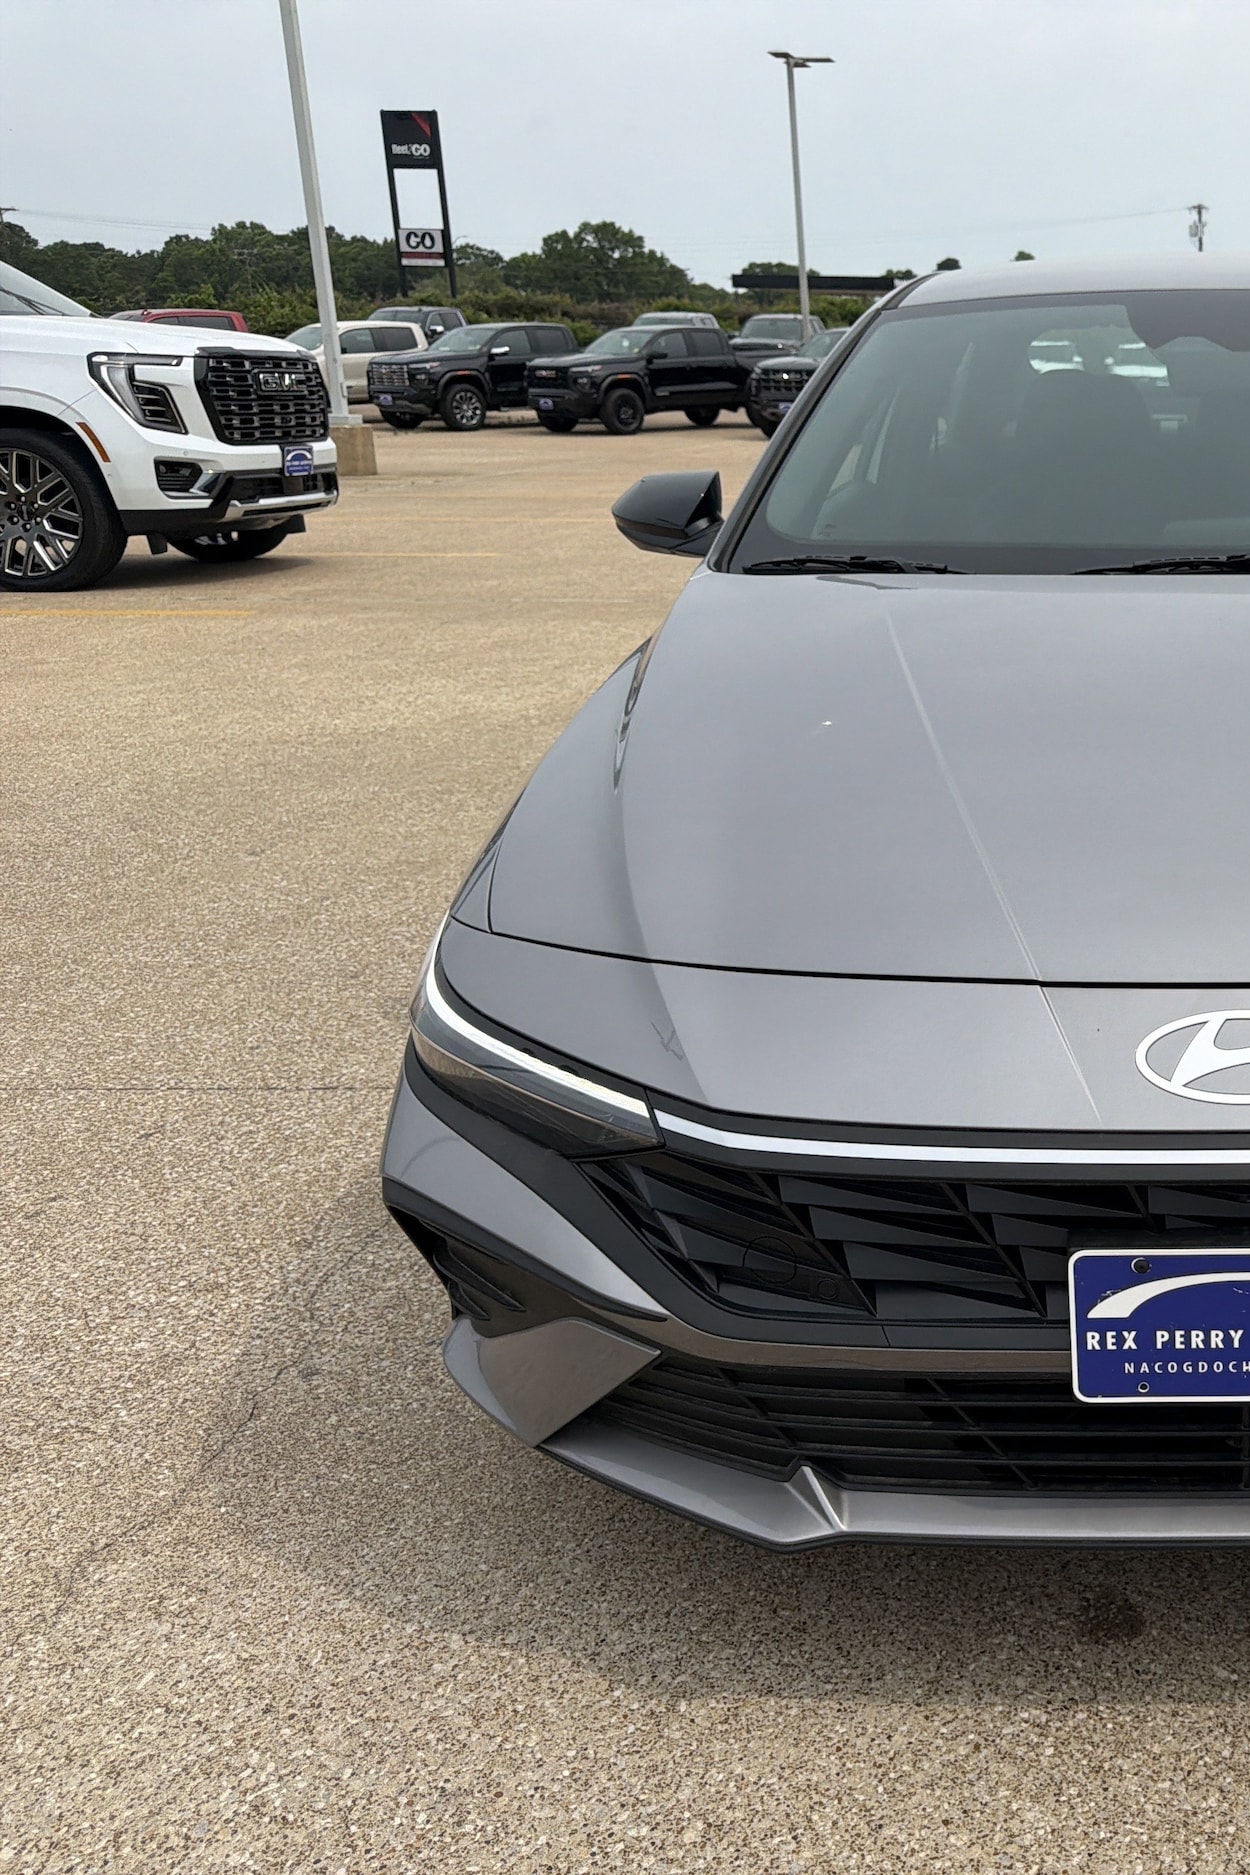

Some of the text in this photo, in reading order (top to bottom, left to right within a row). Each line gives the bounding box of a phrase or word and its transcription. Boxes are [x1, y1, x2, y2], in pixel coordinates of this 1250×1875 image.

[405, 231, 436, 250] GO
[1086, 1330, 1138, 1350] REX
[1155, 1329, 1245, 1350] PERRY
